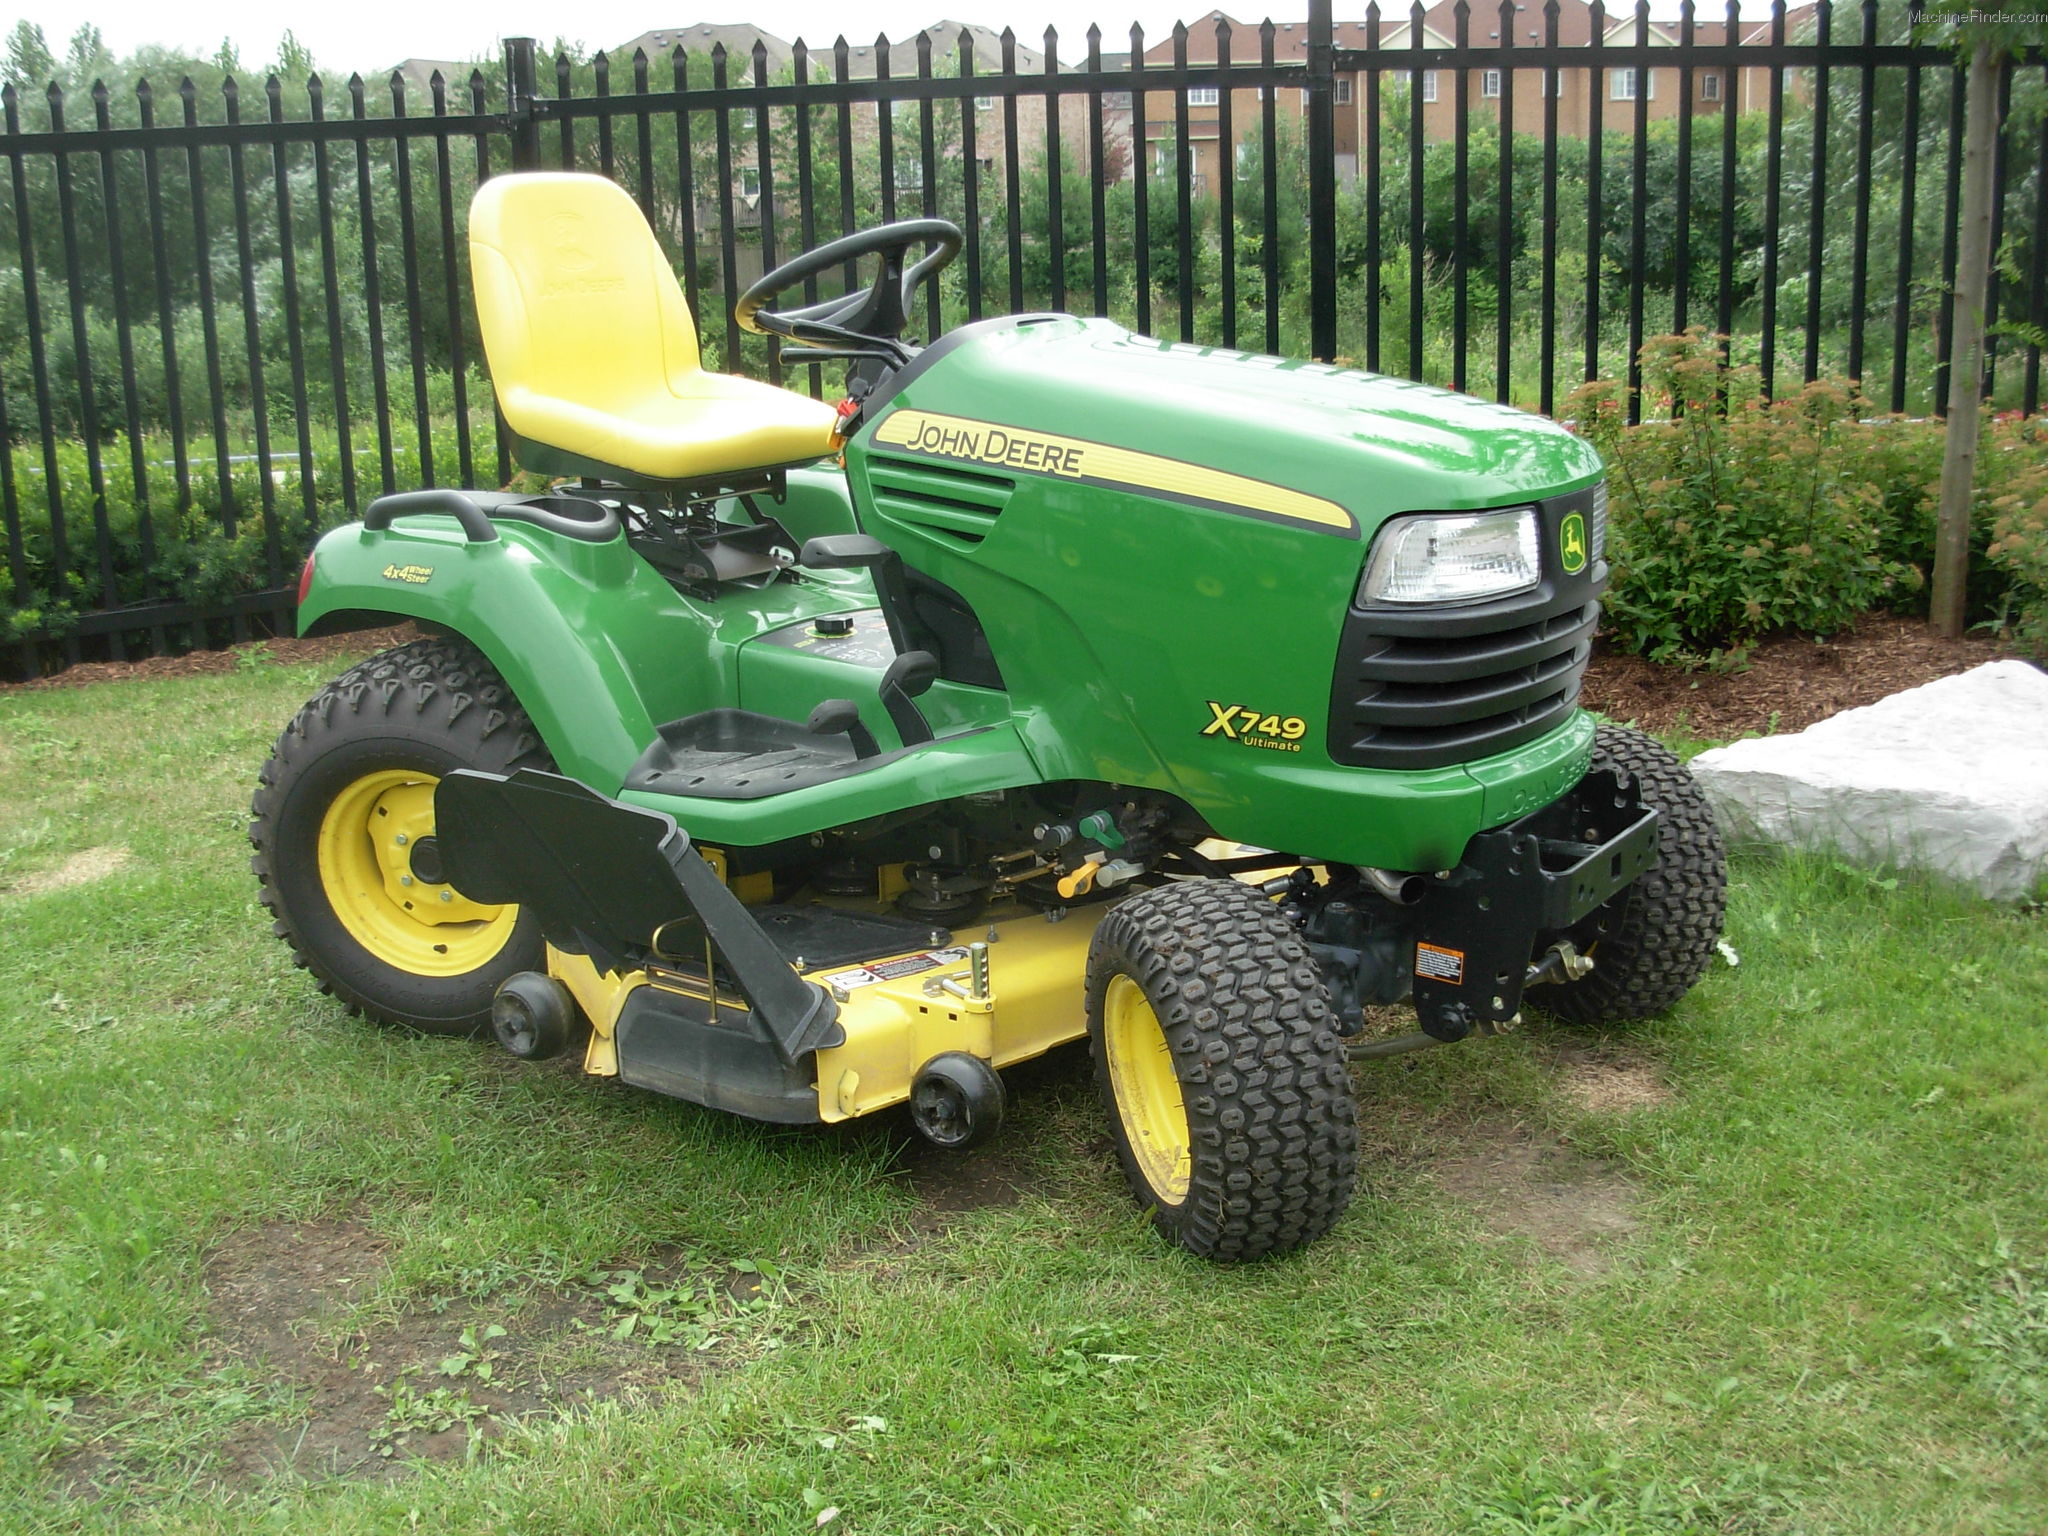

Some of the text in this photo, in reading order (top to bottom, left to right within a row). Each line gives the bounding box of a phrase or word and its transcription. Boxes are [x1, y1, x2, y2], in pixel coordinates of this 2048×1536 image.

[907, 419, 1085, 474] JOHN DEERE
[383, 564, 410, 579] 4x4
[1200, 700, 1306, 740] X749
[1243, 736, 1301, 752] Ultimate
